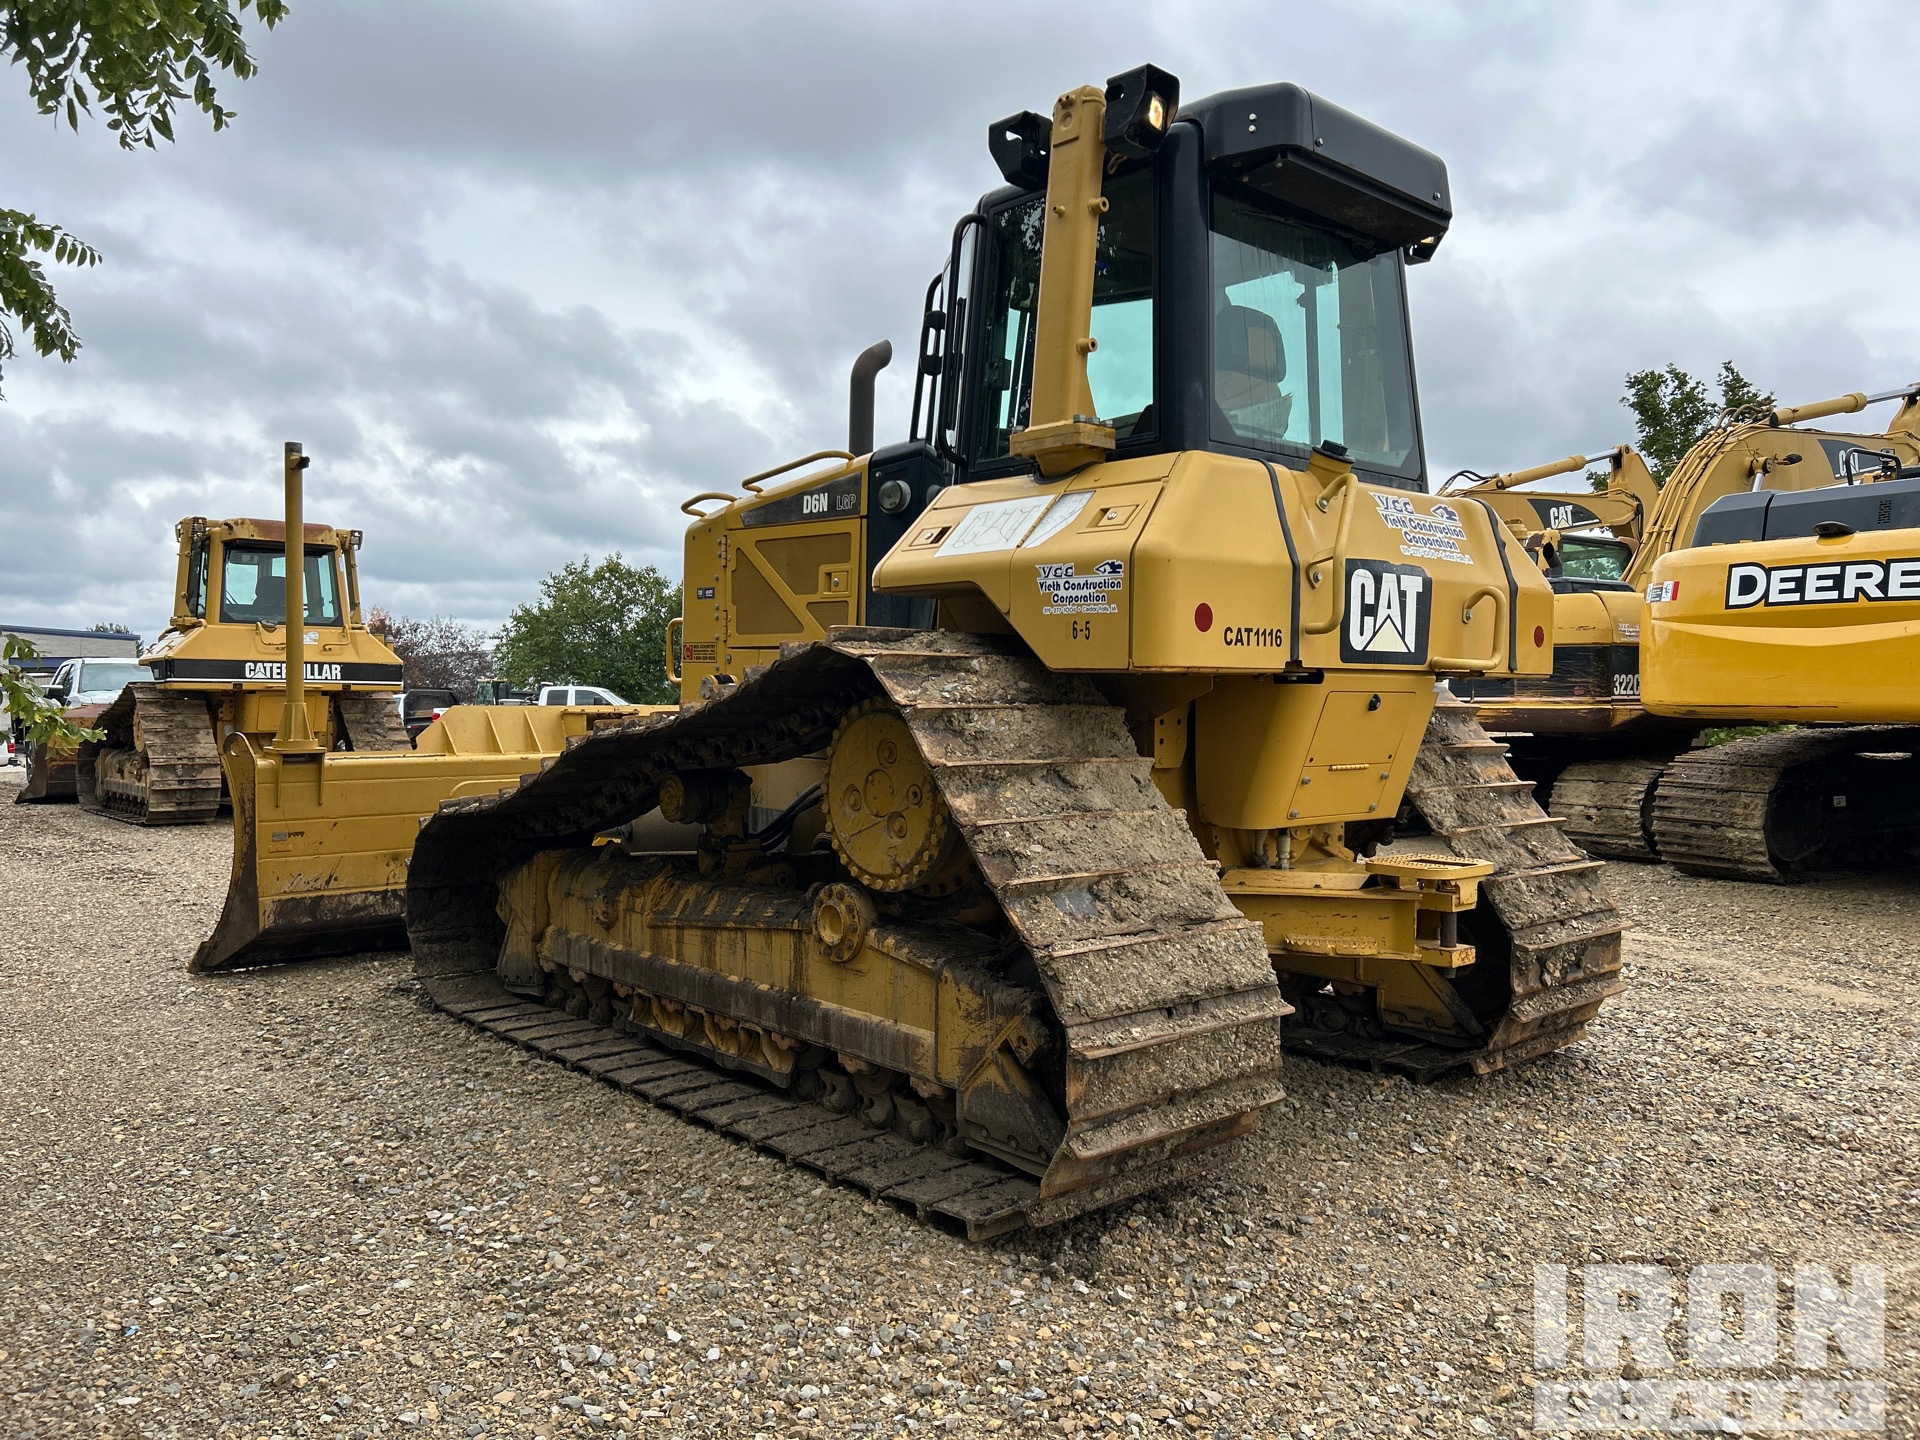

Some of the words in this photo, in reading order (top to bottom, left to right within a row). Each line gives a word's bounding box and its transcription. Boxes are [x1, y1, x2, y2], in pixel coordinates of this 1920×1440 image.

[803, 492, 829, 514] D6N
[836, 493, 857, 511] LGP
[1381, 512, 1409, 529] Vieth
[1408, 517, 1466, 540] Construction
[1549, 504, 1574, 530] CAT
[1403, 530, 1459, 552] Corporation
[1038, 565, 1074, 579] VCC
[1039, 580, 1061, 592] Vieth
[1063, 578, 1122, 591] Construction
[1727, 562, 1920, 607] DEERE
[1052, 591, 1107, 606] Corporation
[1349, 568, 1423, 653] CAT
[1072, 620, 1091, 640] 6-5
[1223, 626, 1283, 648] CAT1116
[245, 662, 342, 680] CATEILLAR
[1613, 673, 1640, 695] 322C
